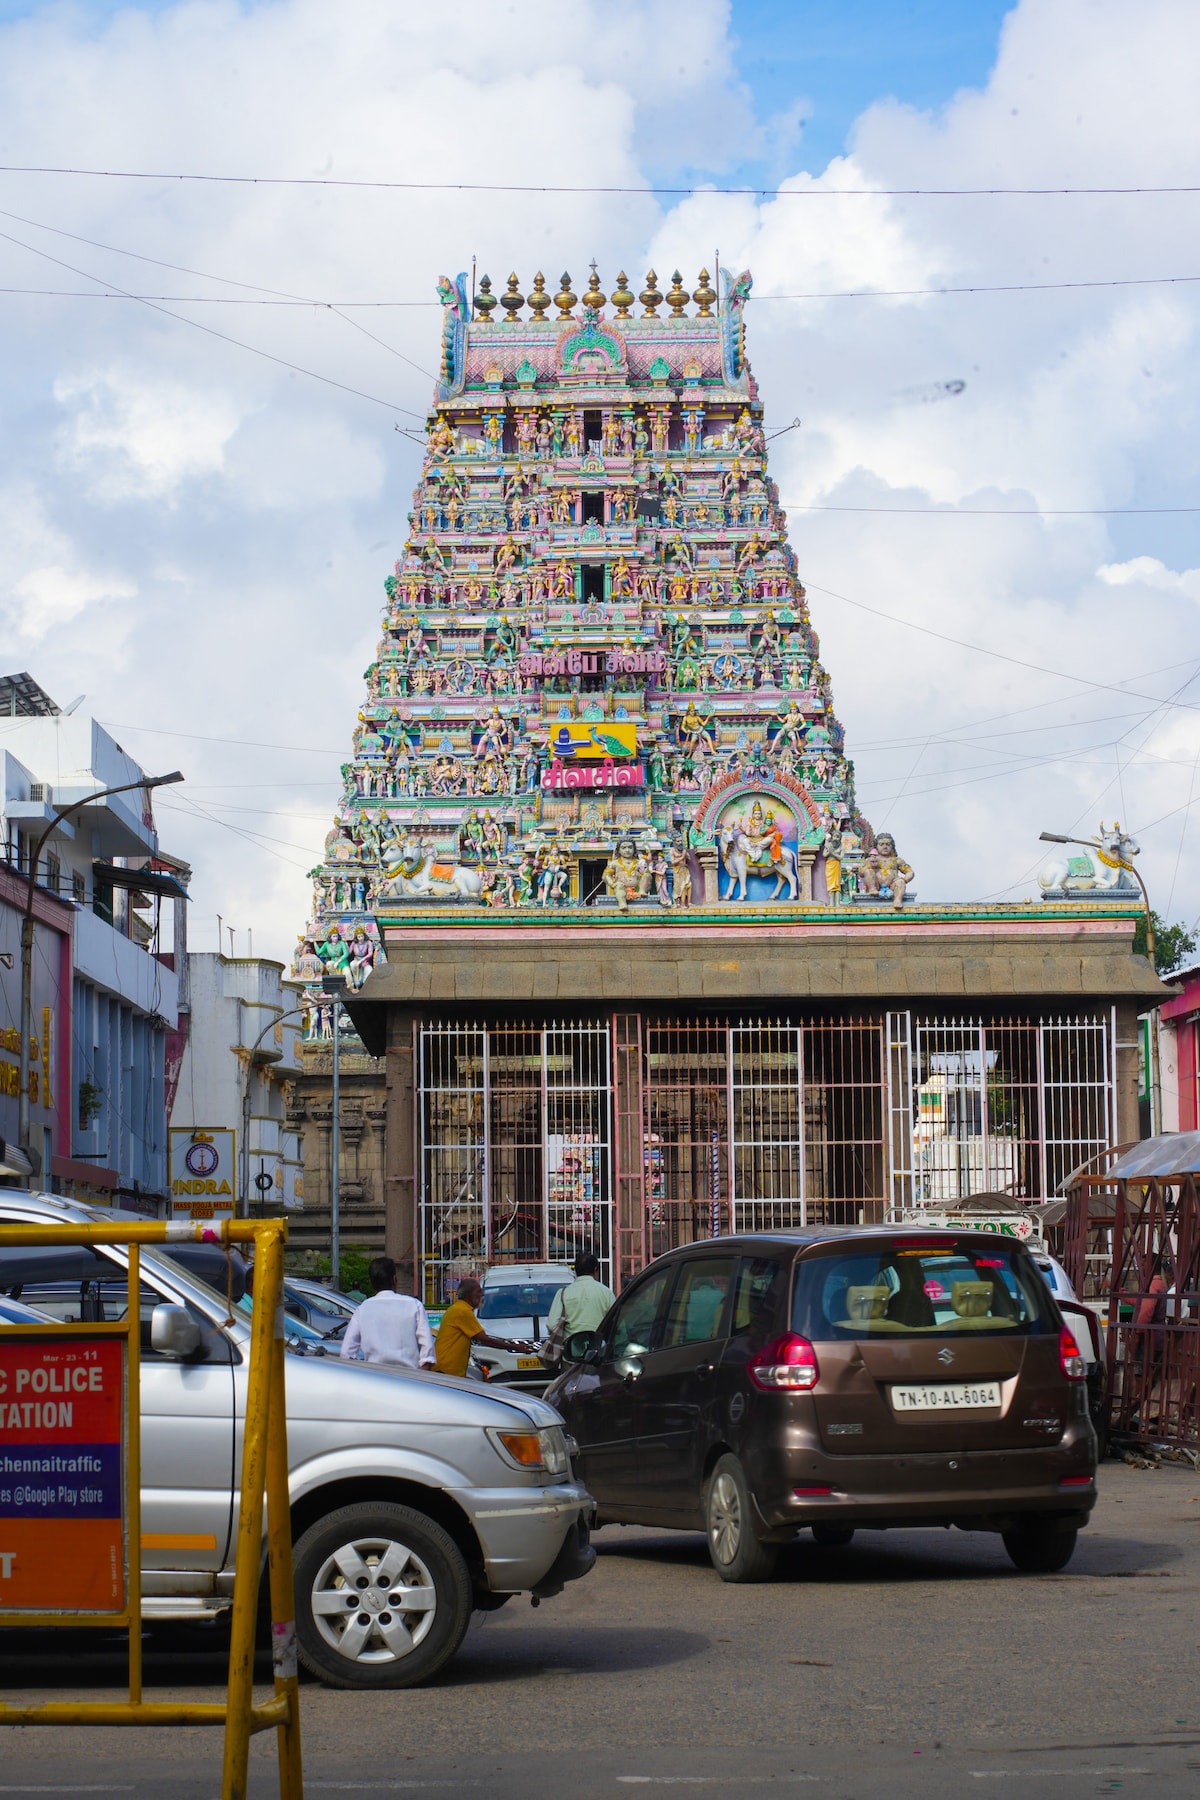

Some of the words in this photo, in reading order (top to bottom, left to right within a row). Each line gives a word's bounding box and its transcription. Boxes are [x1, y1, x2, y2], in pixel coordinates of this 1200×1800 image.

[517, 650, 598, 675] அன்பே
[173, 1179, 231, 1194] INDRA
[42, 1354, 59, 1362] Mar
[66, 1353, 77, 1361] 23
[83, 1350, 98, 1360] 11
[15, 1366, 104, 1394] POLICE
[899, 1388, 995, 1406] TN-10-AL-6064
[13, 1485, 56, 1507] @Google
[58, 1485, 78, 1507] Play
[79, 1486, 103, 1503] store
[0, 1552, 17, 1579] T
